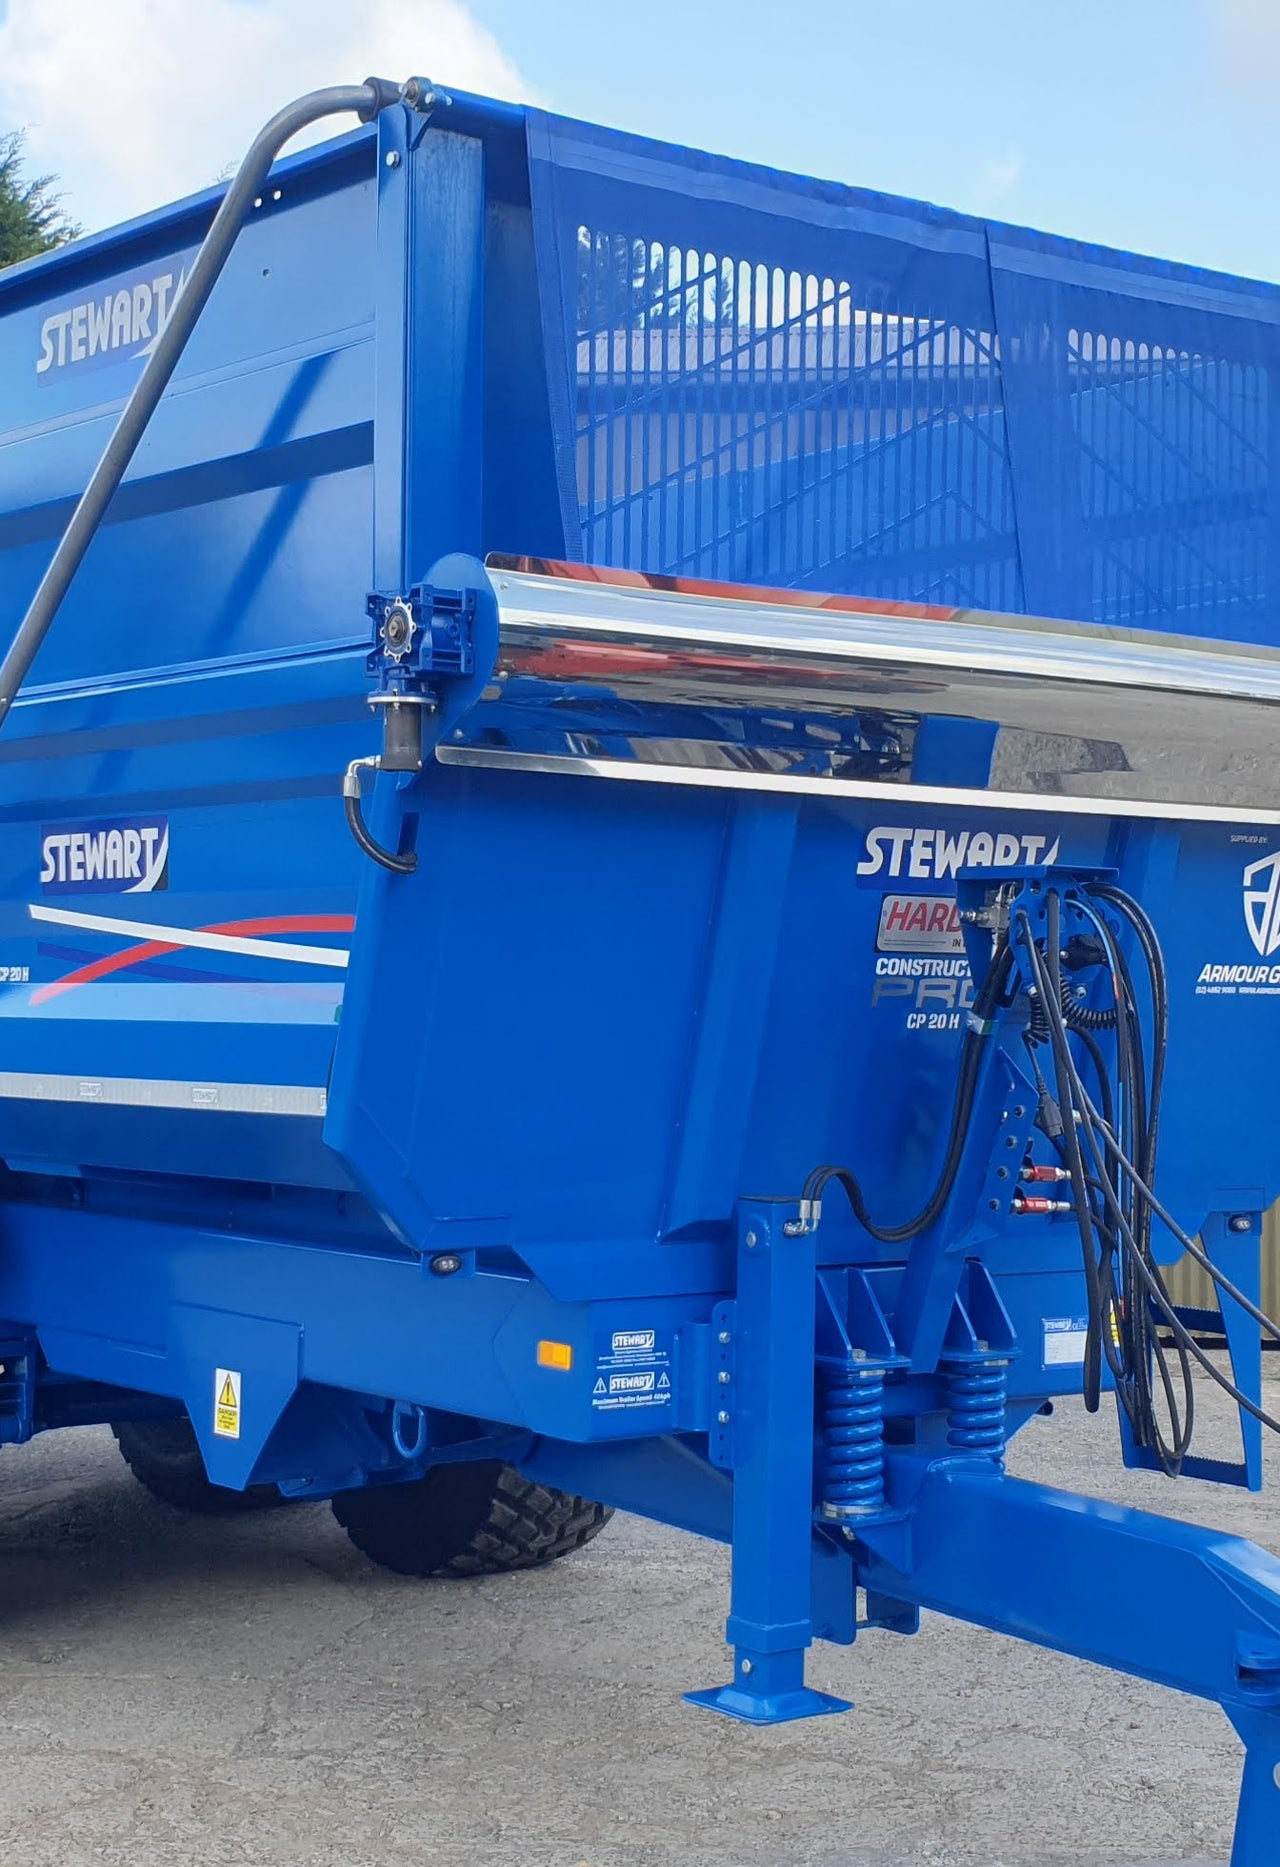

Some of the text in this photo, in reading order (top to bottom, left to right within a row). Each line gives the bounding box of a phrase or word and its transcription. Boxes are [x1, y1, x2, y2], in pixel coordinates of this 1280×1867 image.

[36, 268, 183, 373] STEWART
[40, 823, 168, 893] STEWART
[856, 827, 1060, 879] STEWART
[1198, 963, 1270, 983] ARMOUR
[906, 1013, 960, 1029] CP 20 H
[614, 1334, 653, 1348] STEWART
[611, 1375, 653, 1390] STEWART
